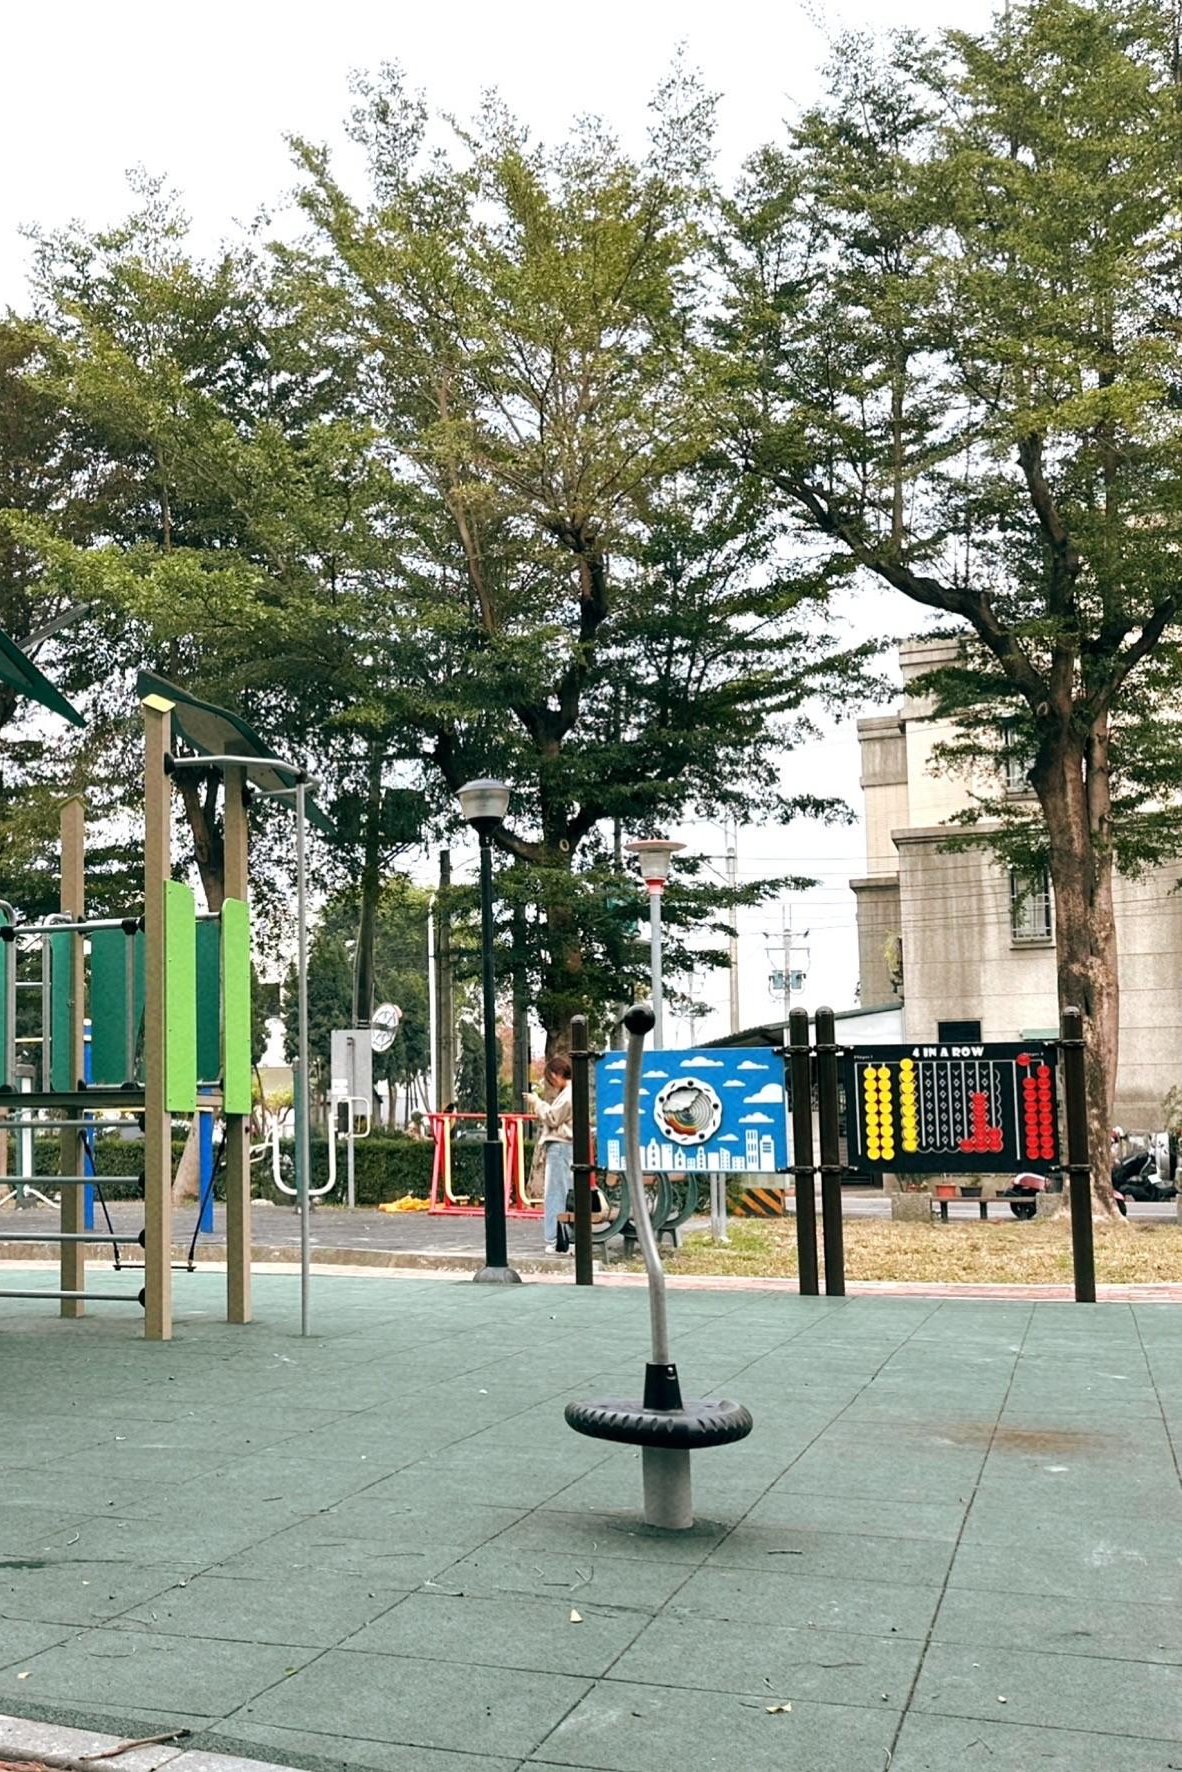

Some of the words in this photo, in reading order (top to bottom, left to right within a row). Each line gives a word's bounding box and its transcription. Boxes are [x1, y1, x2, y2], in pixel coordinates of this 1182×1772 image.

[912, 1047, 920, 1057] 4
[923, 1047, 937, 1057] IN
[940, 1047, 949, 1057] A
[952, 1046, 985, 1057] ROW
